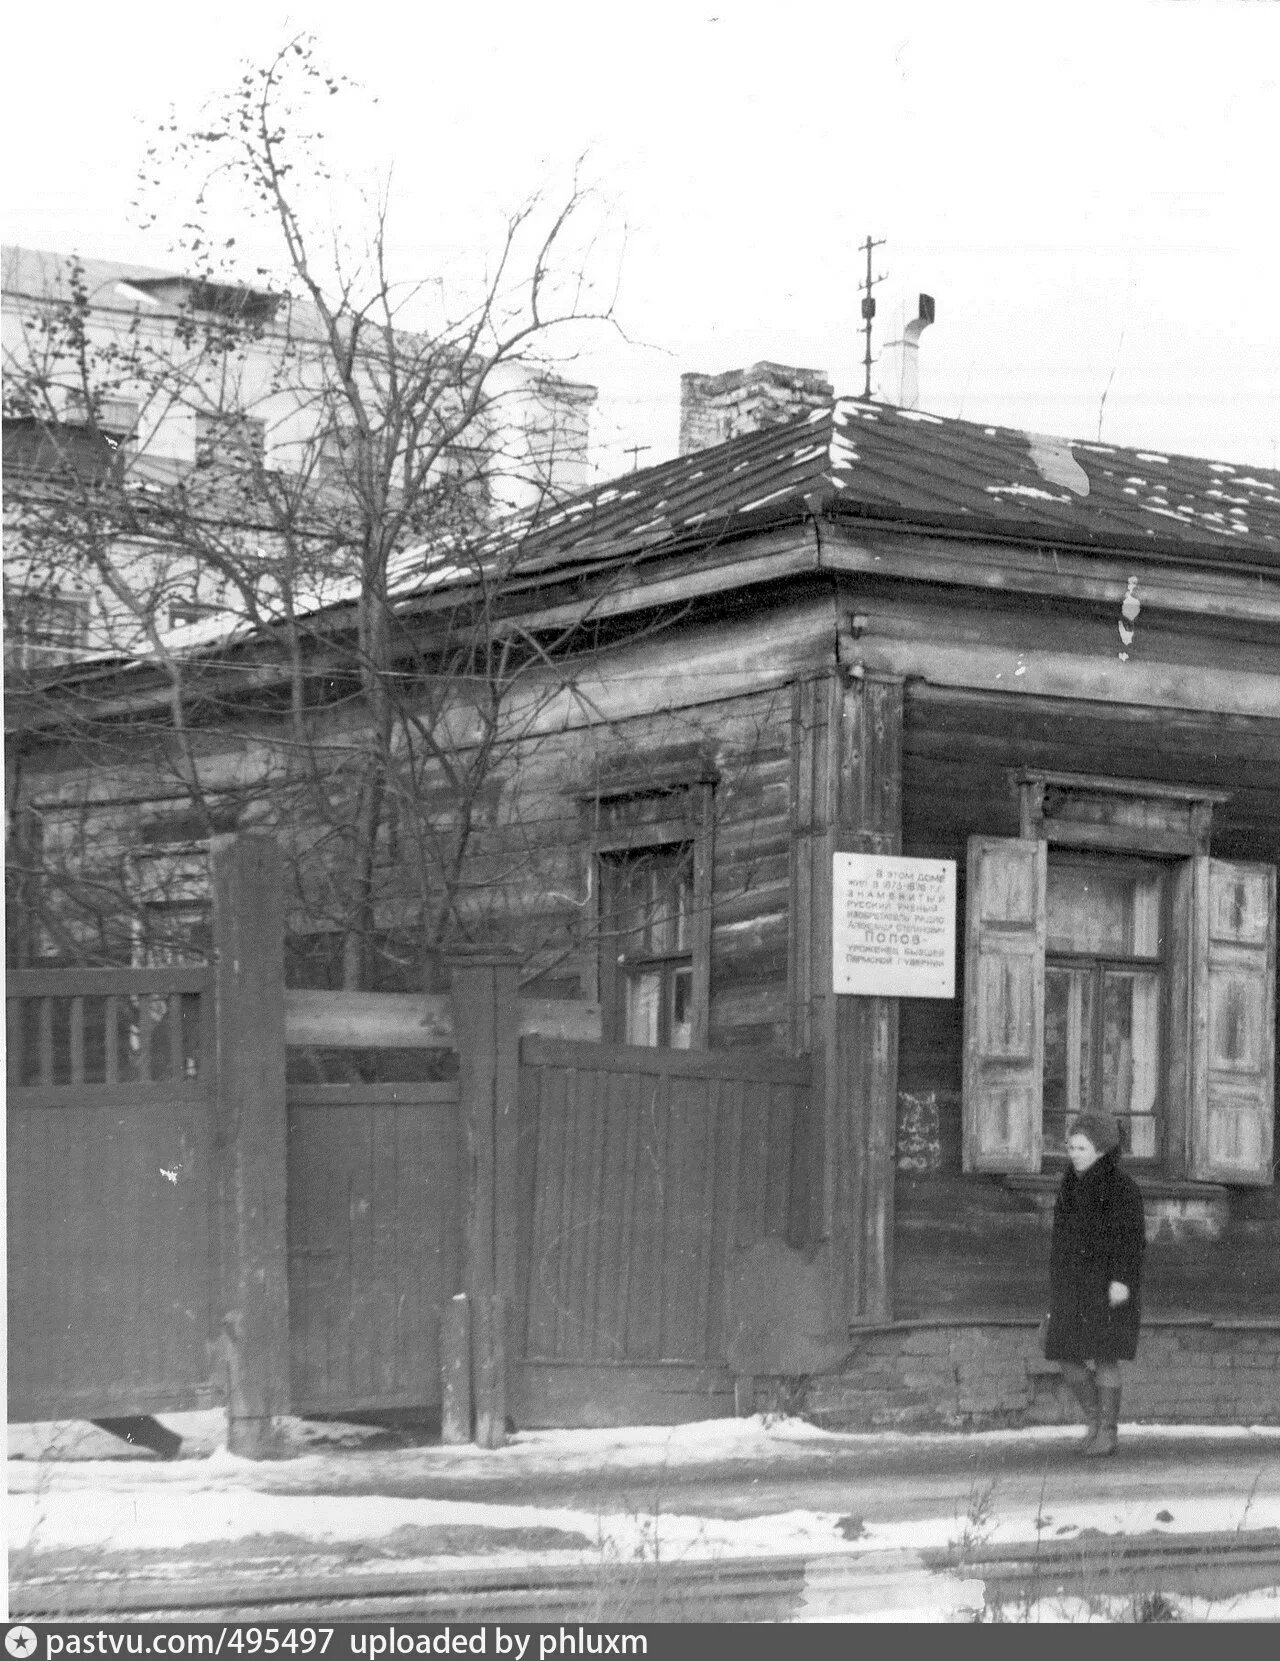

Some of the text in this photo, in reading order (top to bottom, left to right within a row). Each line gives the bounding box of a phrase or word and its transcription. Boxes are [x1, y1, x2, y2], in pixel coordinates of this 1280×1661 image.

[876, 869, 945, 882] В ЭТОМ ДОМЕ
[873, 880, 879, 889] В
[846, 900, 891, 909] РУССКИЙ
[846, 910, 945, 924] ИЗОБРЕТАТЕЛЬ РАДИО
[848, 944, 945, 957] УРОЖЕНЕЦ БЫВШЕЙ
